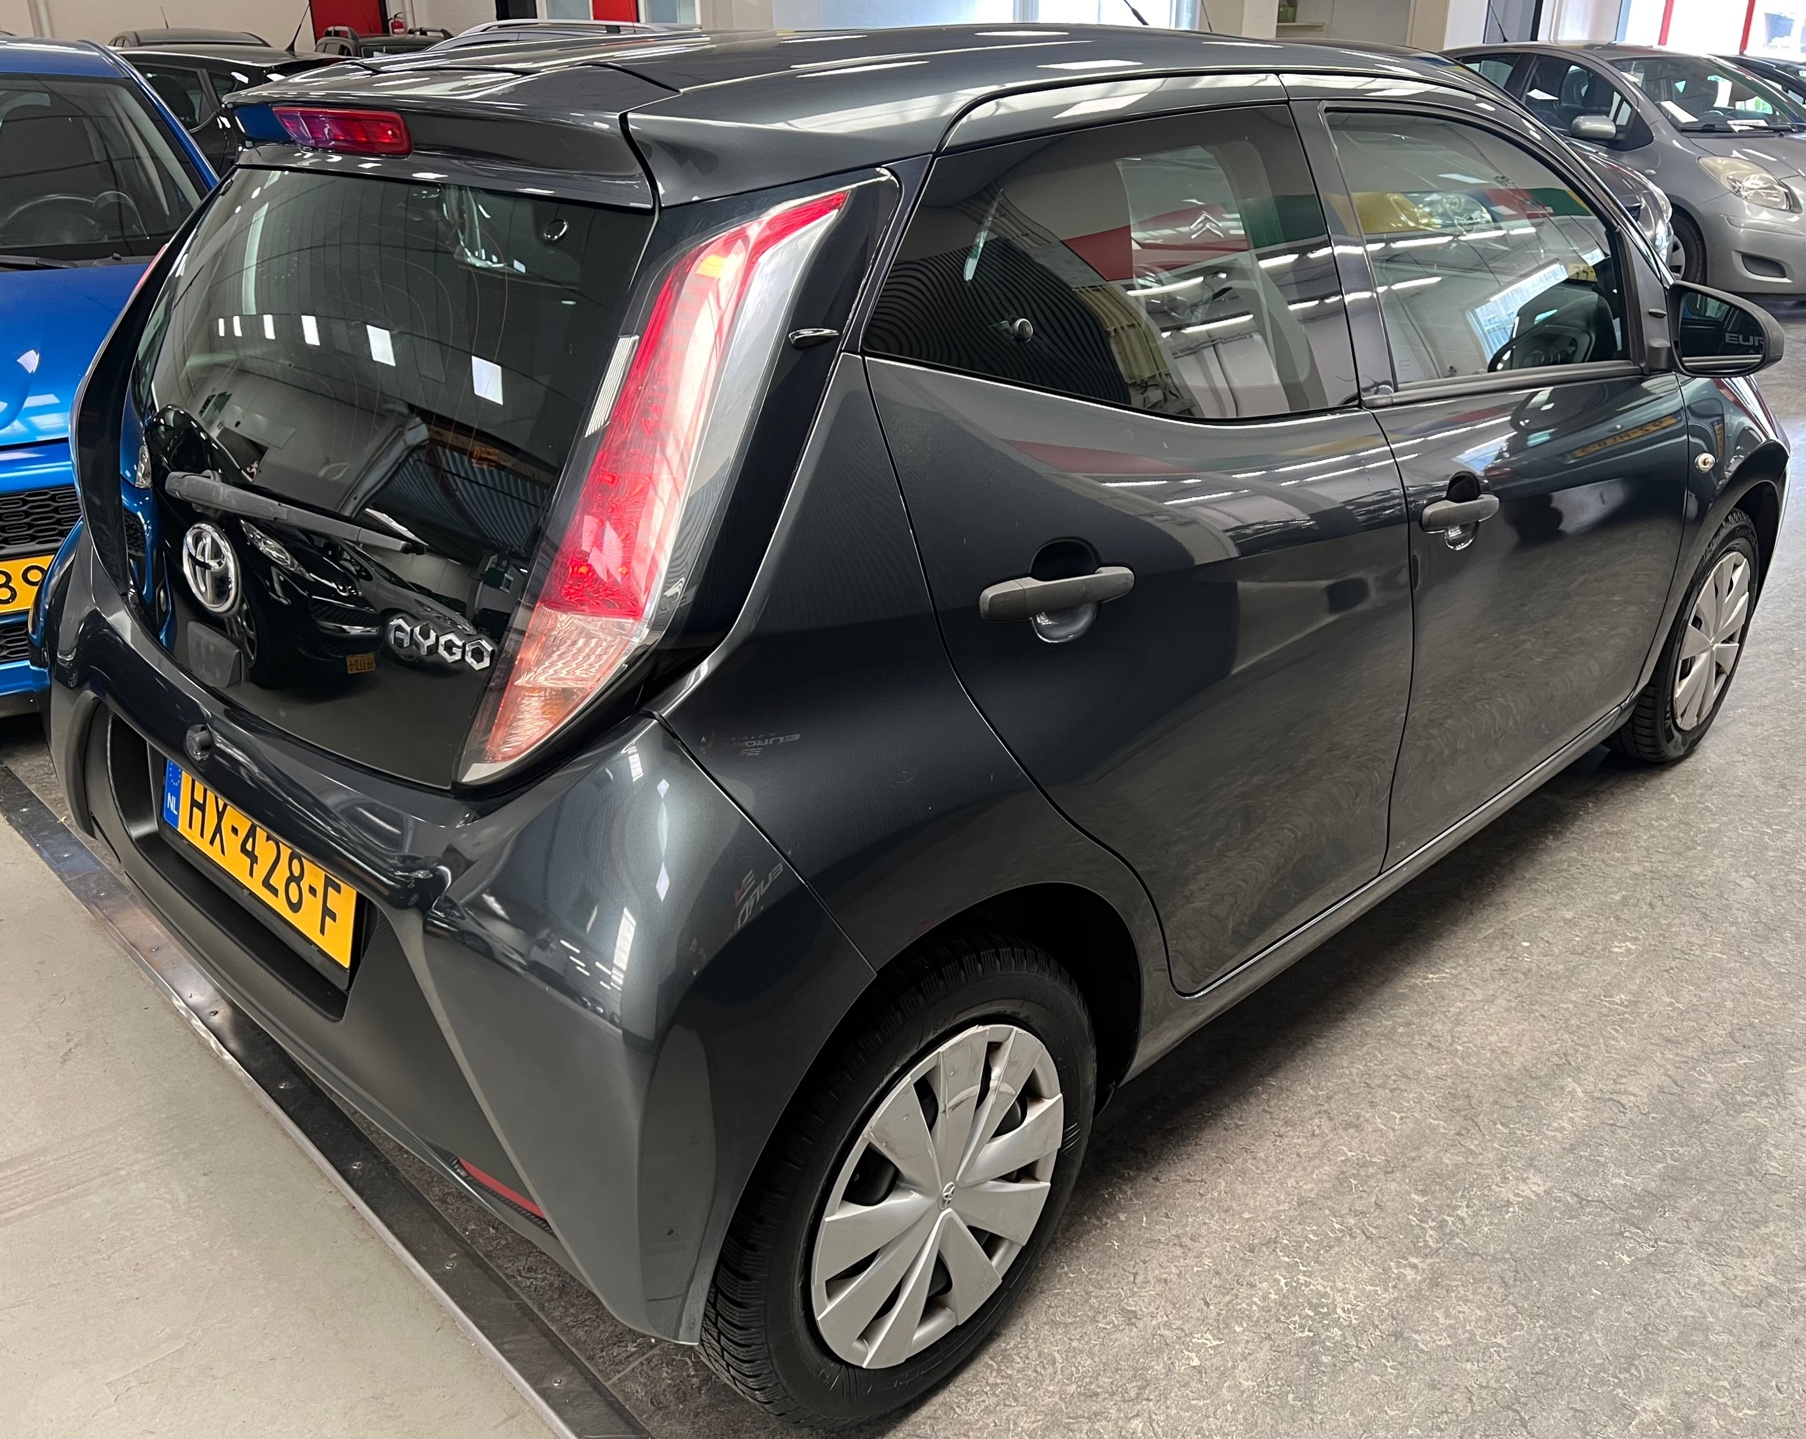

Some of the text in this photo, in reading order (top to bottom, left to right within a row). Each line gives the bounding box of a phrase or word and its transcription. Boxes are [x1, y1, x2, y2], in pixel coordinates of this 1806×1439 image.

[389, 618, 494, 671] AYGO
[166, 792, 178, 815] NL
[188, 779, 342, 937] HX-428-F
